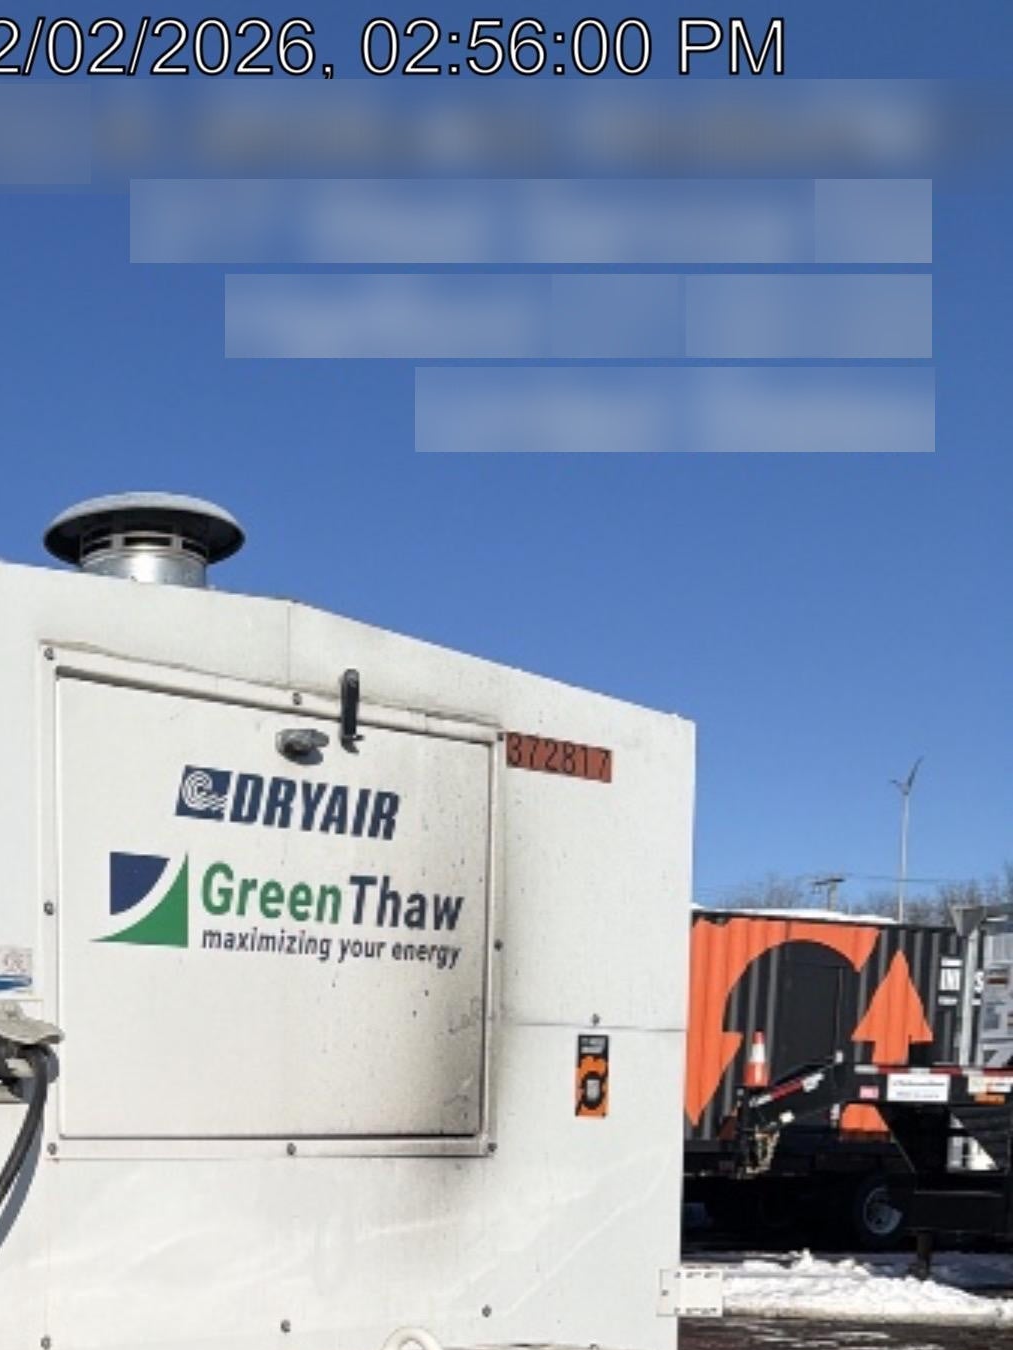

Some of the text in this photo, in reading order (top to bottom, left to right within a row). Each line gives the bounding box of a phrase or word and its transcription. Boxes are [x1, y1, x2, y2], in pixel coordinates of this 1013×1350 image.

[506, 732, 611, 782] 372817
[229, 773, 401, 841] DRYAIR
[201, 926, 463, 970] maximizing your energy
